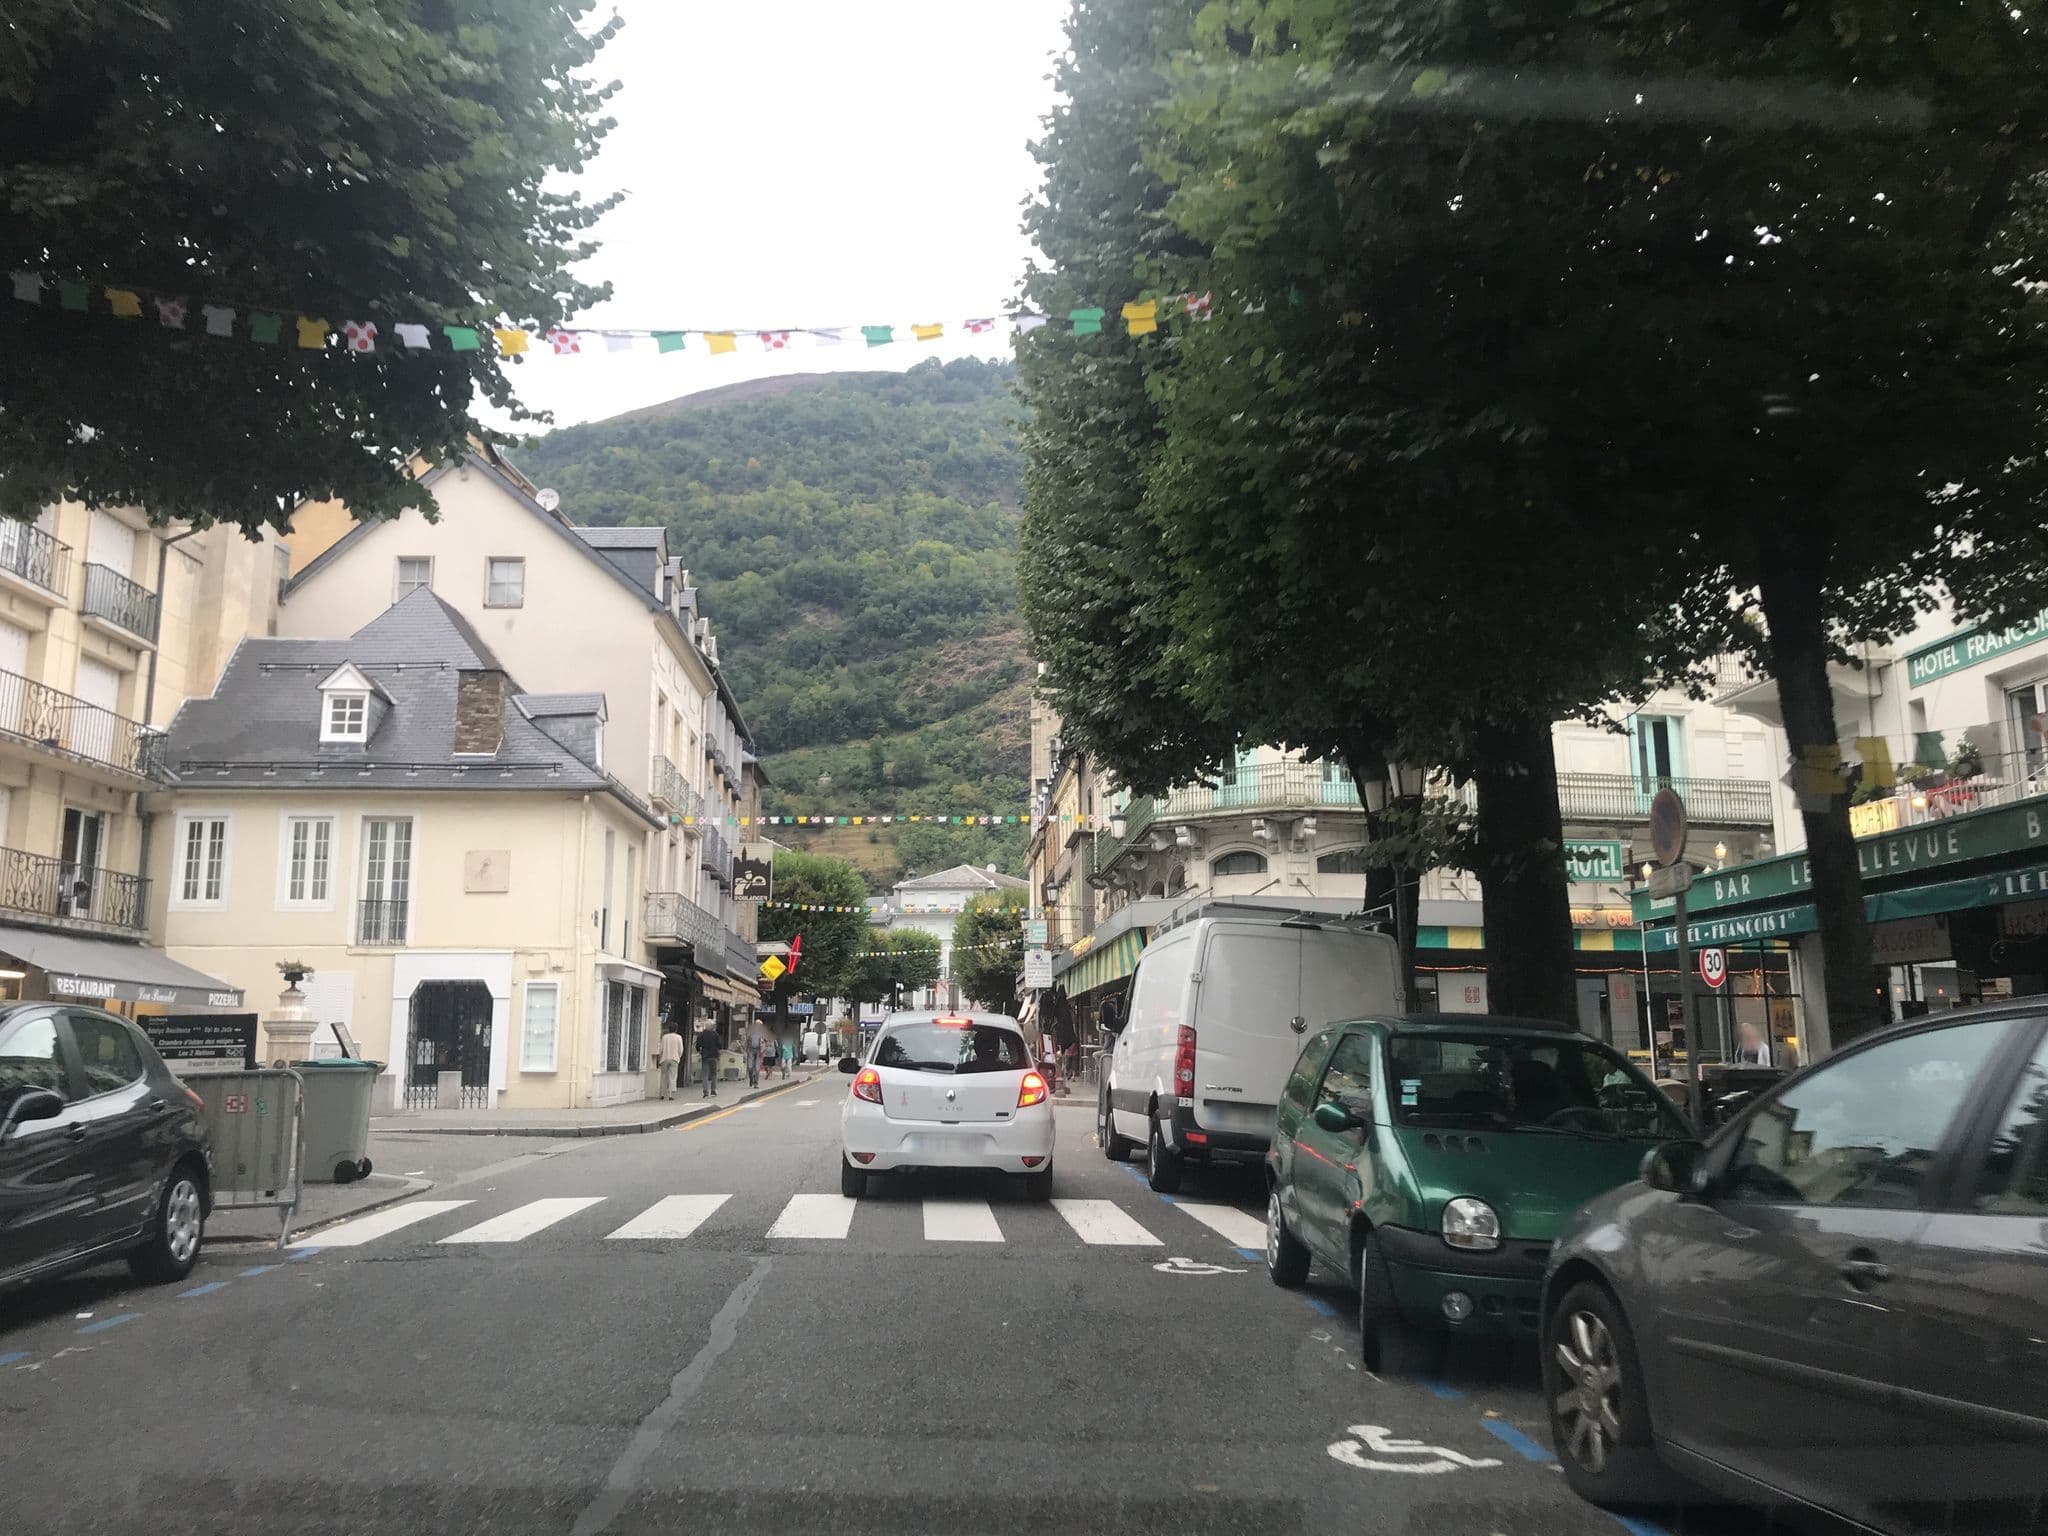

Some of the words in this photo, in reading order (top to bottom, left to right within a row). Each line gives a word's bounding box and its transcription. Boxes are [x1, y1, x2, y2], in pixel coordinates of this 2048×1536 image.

[1914, 645, 1959, 679] HOTEL
[1714, 874, 1751, 900] BAR
[1790, 860, 1813, 885] LE
[1858, 828, 1958, 872] LLEVUE
[1665, 927, 1701, 945] HOEL
[1711, 914, 1776, 939] FRANÇOIS
[1705, 953, 1721, 973] 30
[57, 978, 116, 998] RESTAURANT
[208, 992, 239, 1007] PIZZERIA
